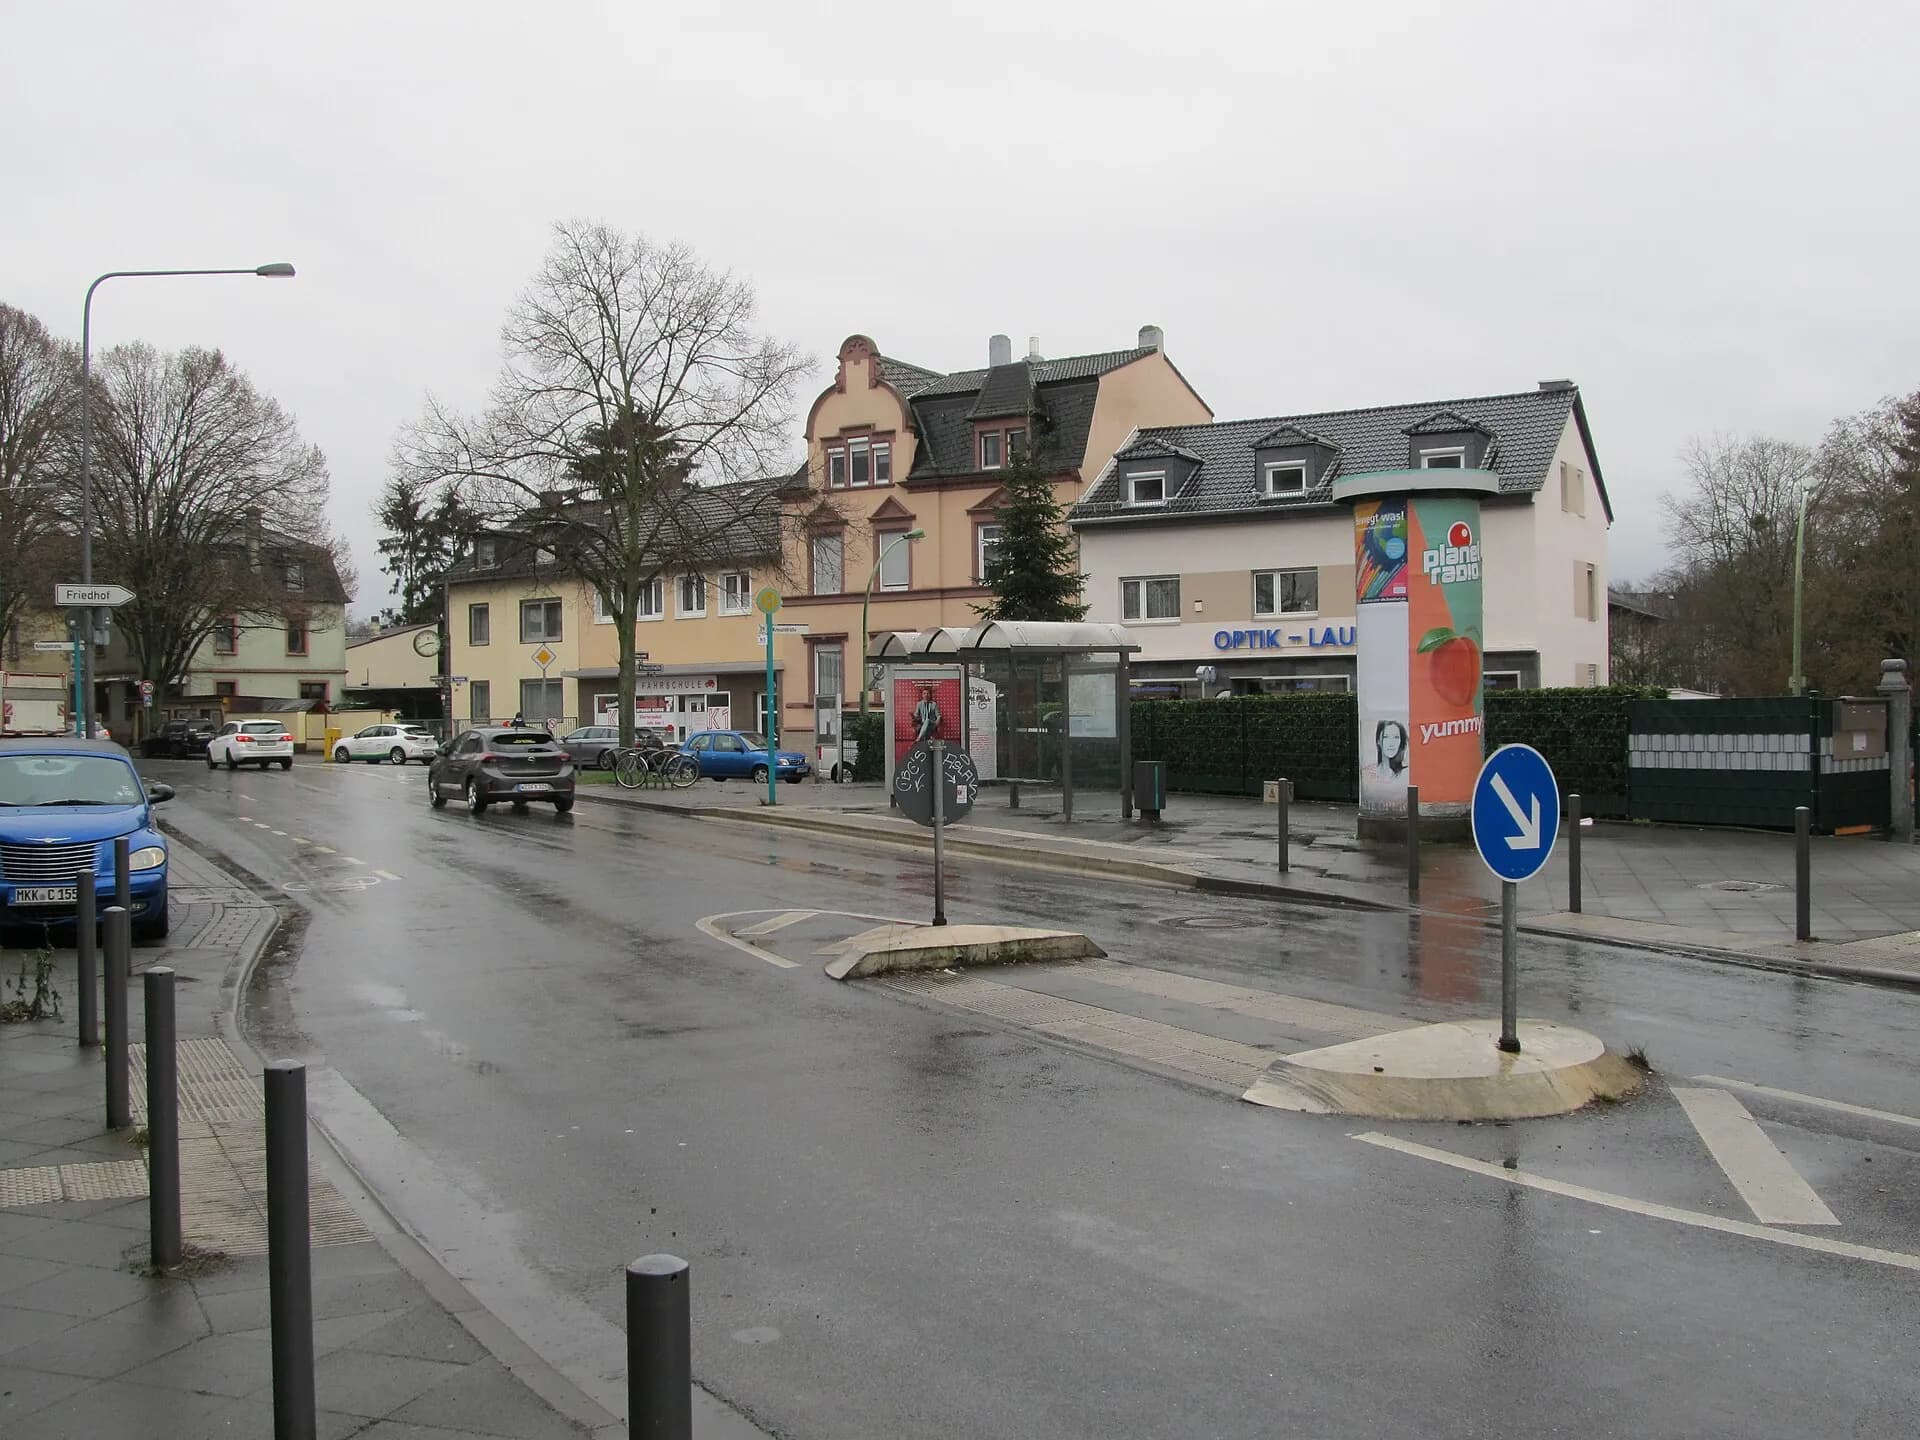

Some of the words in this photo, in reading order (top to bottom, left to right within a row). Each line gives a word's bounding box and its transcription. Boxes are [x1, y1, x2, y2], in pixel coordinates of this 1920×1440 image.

[1381, 510, 1404, 521] was!
[66, 590, 110, 600] Friedhof
[1214, 629, 1281, 650] OPTIK
[641, 681, 702, 689] FAHRSCHULE
[708, 708, 729, 730] K1
[1420, 715, 1481, 745] yummy
[16, 889, 39, 901] MKK
[47, 888, 55, 900] C
